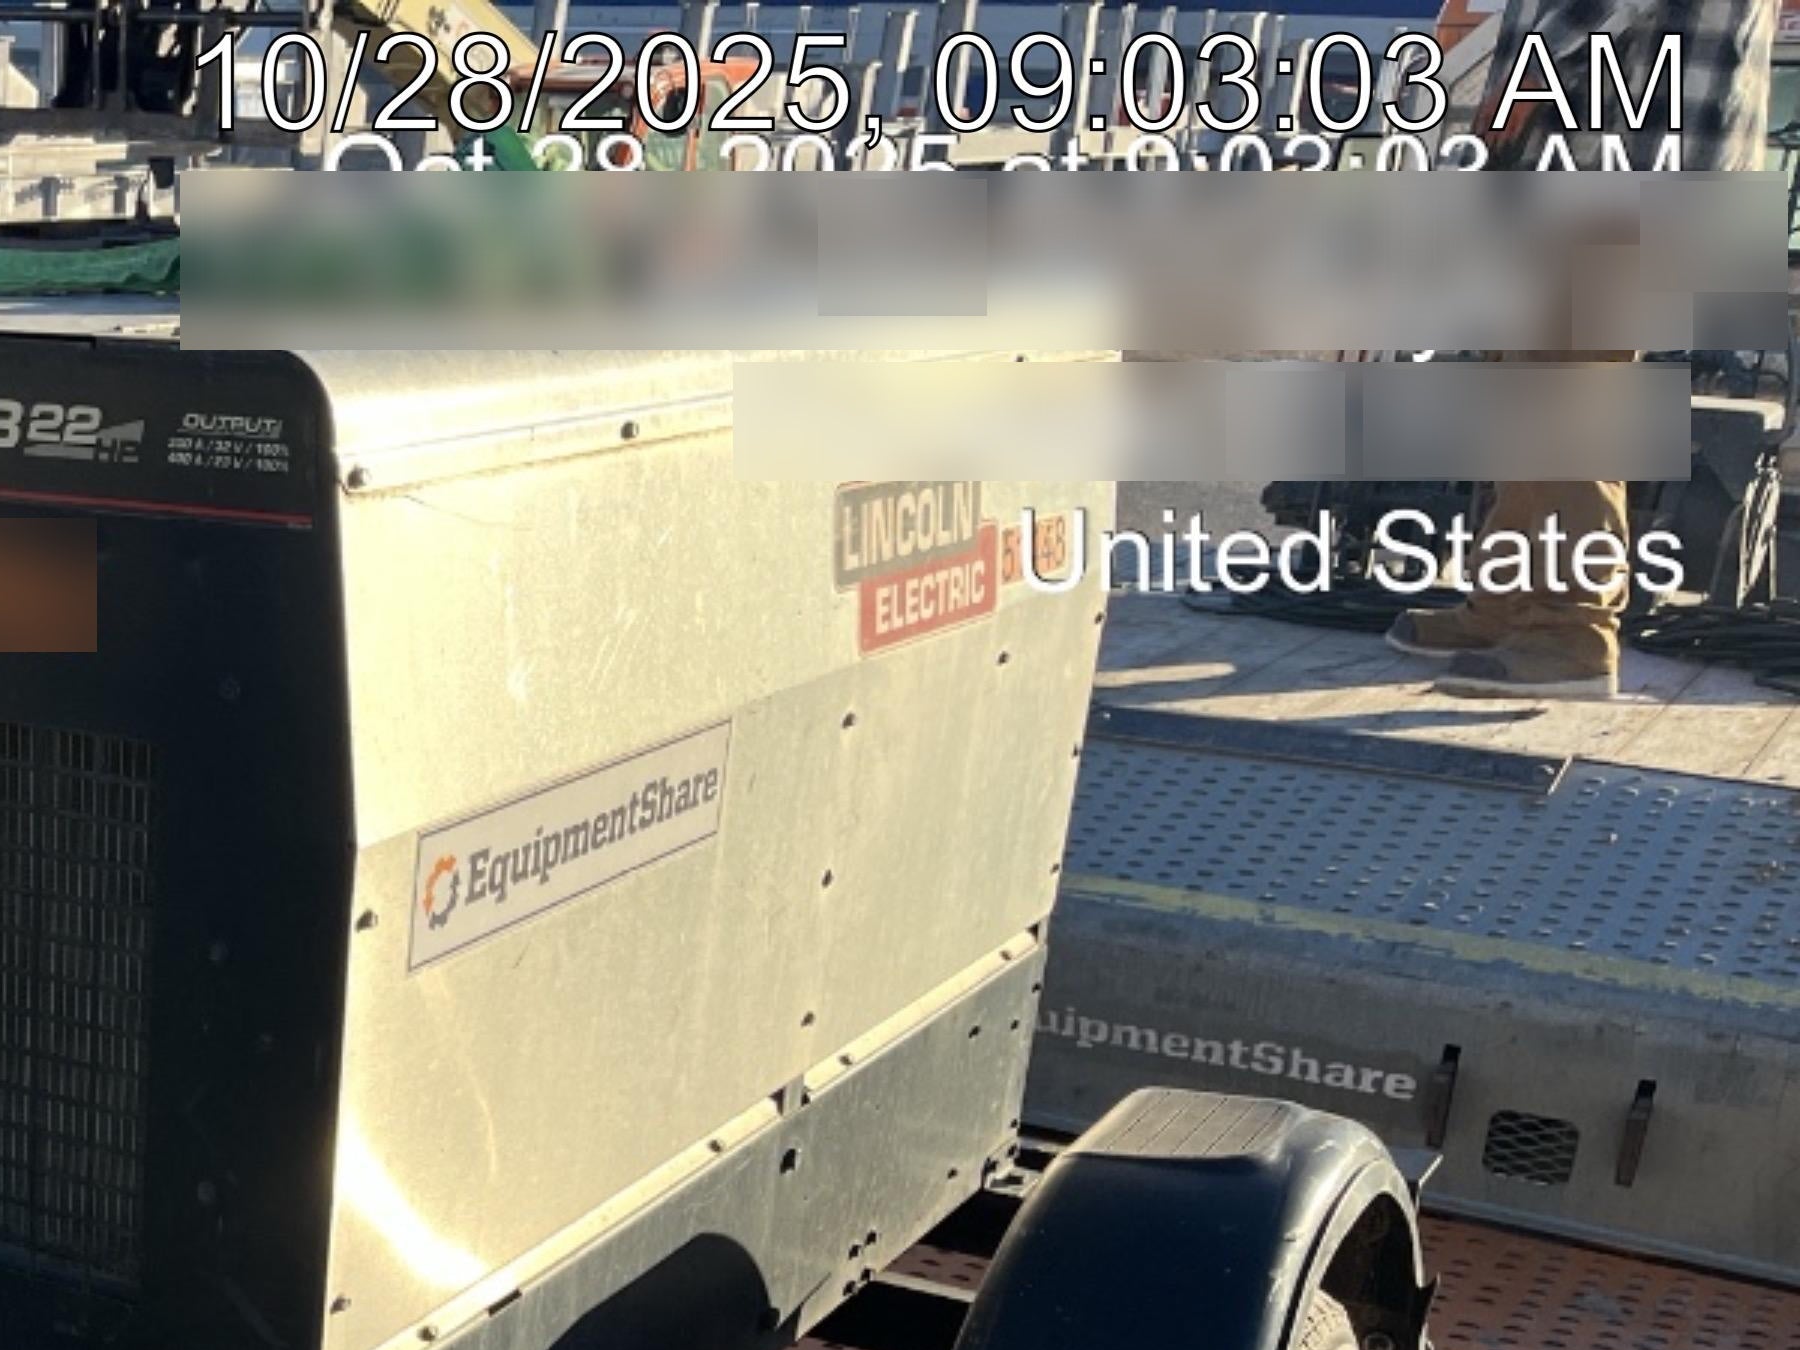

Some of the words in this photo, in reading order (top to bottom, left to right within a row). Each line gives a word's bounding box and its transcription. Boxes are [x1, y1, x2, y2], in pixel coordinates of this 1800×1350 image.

[182, 413, 277, 434] OUTPUT
[842, 481, 974, 571] LINCOLN
[875, 559, 986, 635] ELECTRIC
[464, 767, 719, 904] EquipmentShare
